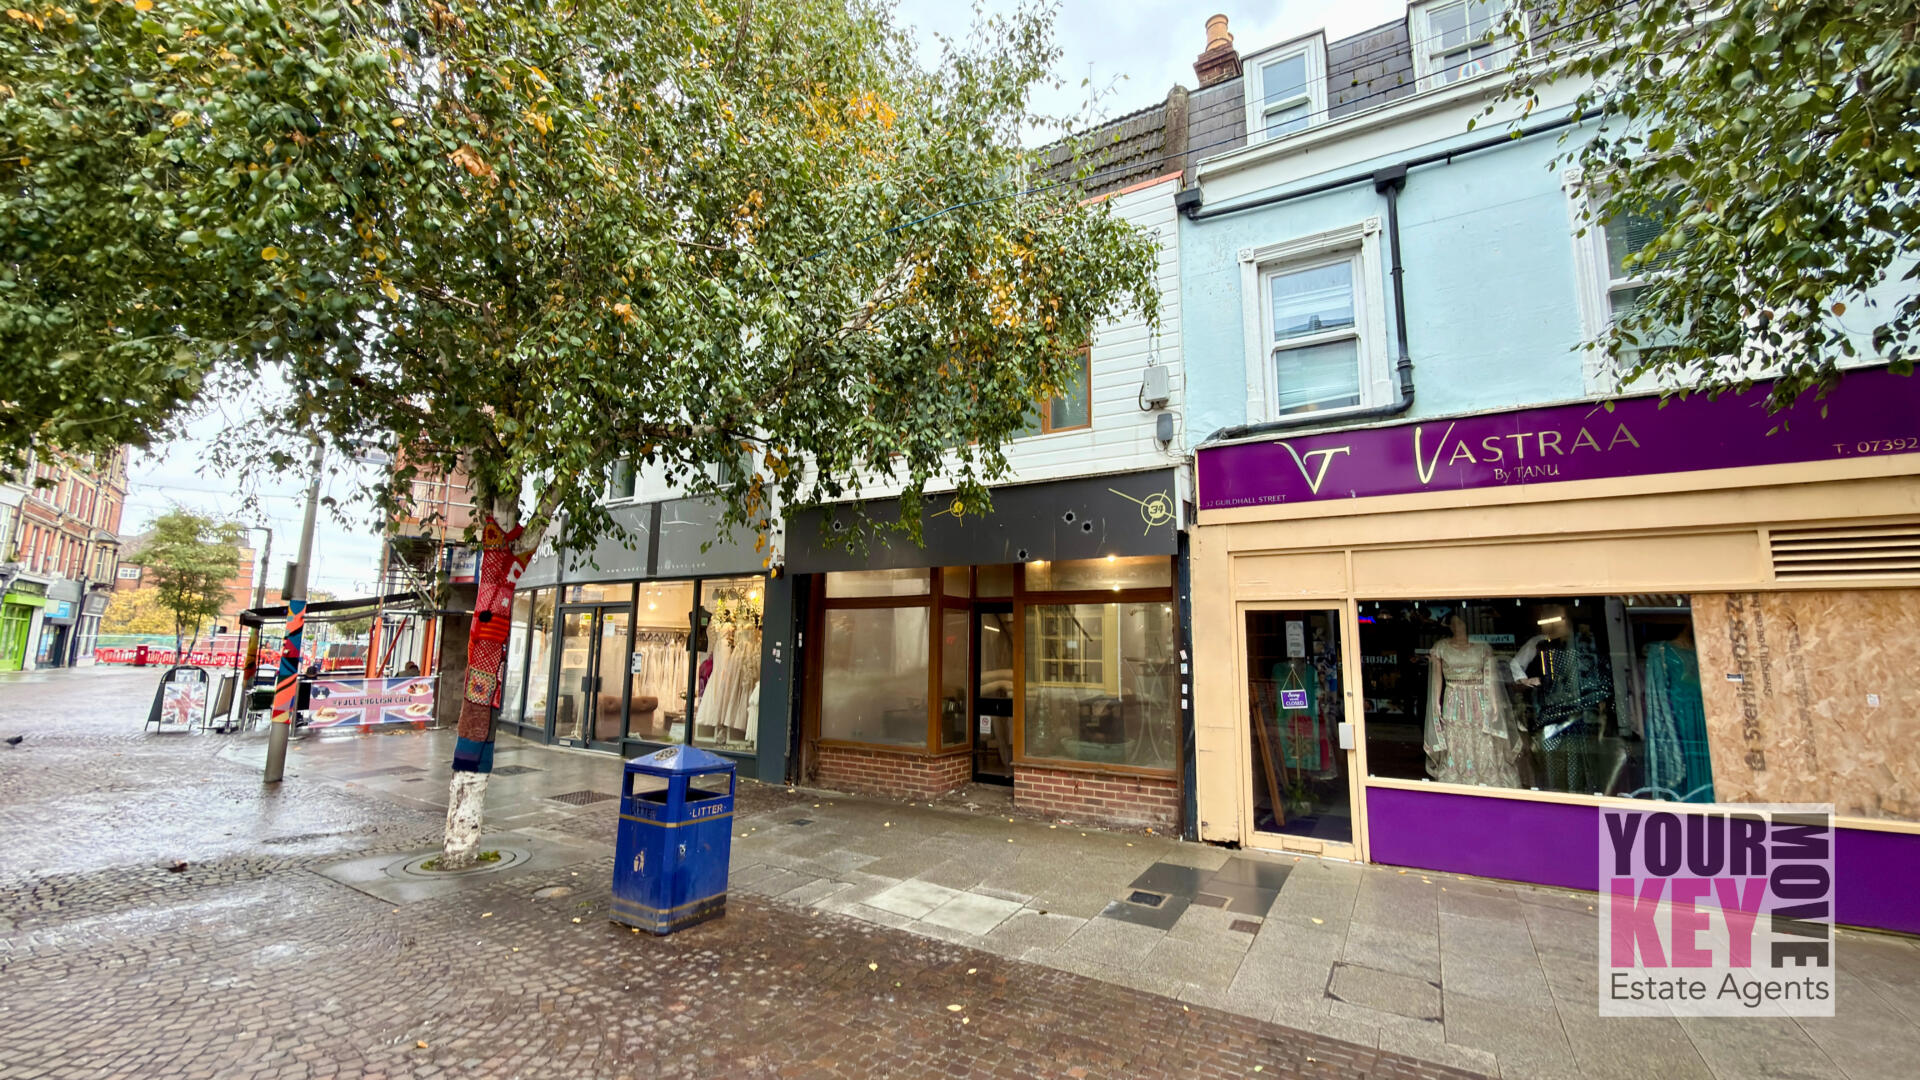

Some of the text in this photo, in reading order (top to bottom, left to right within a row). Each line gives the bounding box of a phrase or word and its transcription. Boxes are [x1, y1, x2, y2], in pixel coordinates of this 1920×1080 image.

[1414, 422, 1640, 483] VASTRAA
[1857, 437, 1919, 453] 07392
[1494, 464, 1560, 483] By TANU
[1215, 496, 1257, 507] GUILDHALL
[1258, 494, 1287, 503] STREET
[1150, 505, 1163, 514] 34
[692, 804, 723, 818] LITTER
